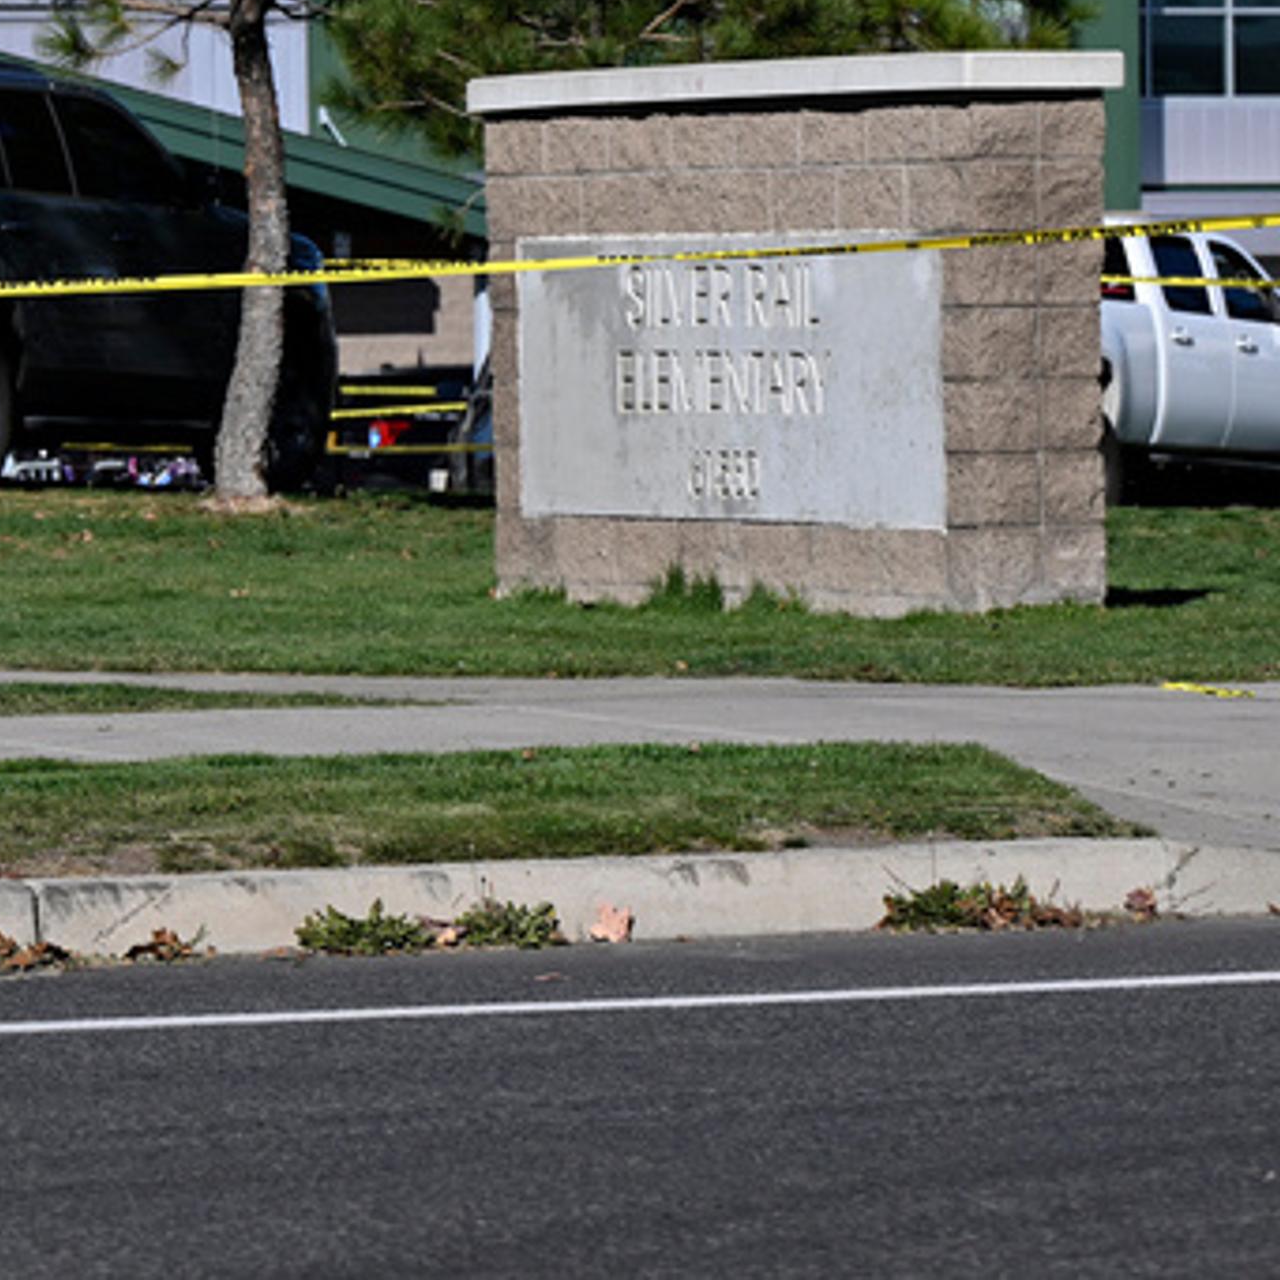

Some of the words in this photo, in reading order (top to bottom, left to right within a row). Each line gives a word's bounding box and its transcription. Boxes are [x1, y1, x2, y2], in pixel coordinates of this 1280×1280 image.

[623, 263, 733, 328] SILVER
[744, 263, 822, 327] RAIL
[616, 348, 831, 414] ELEMENTARY
